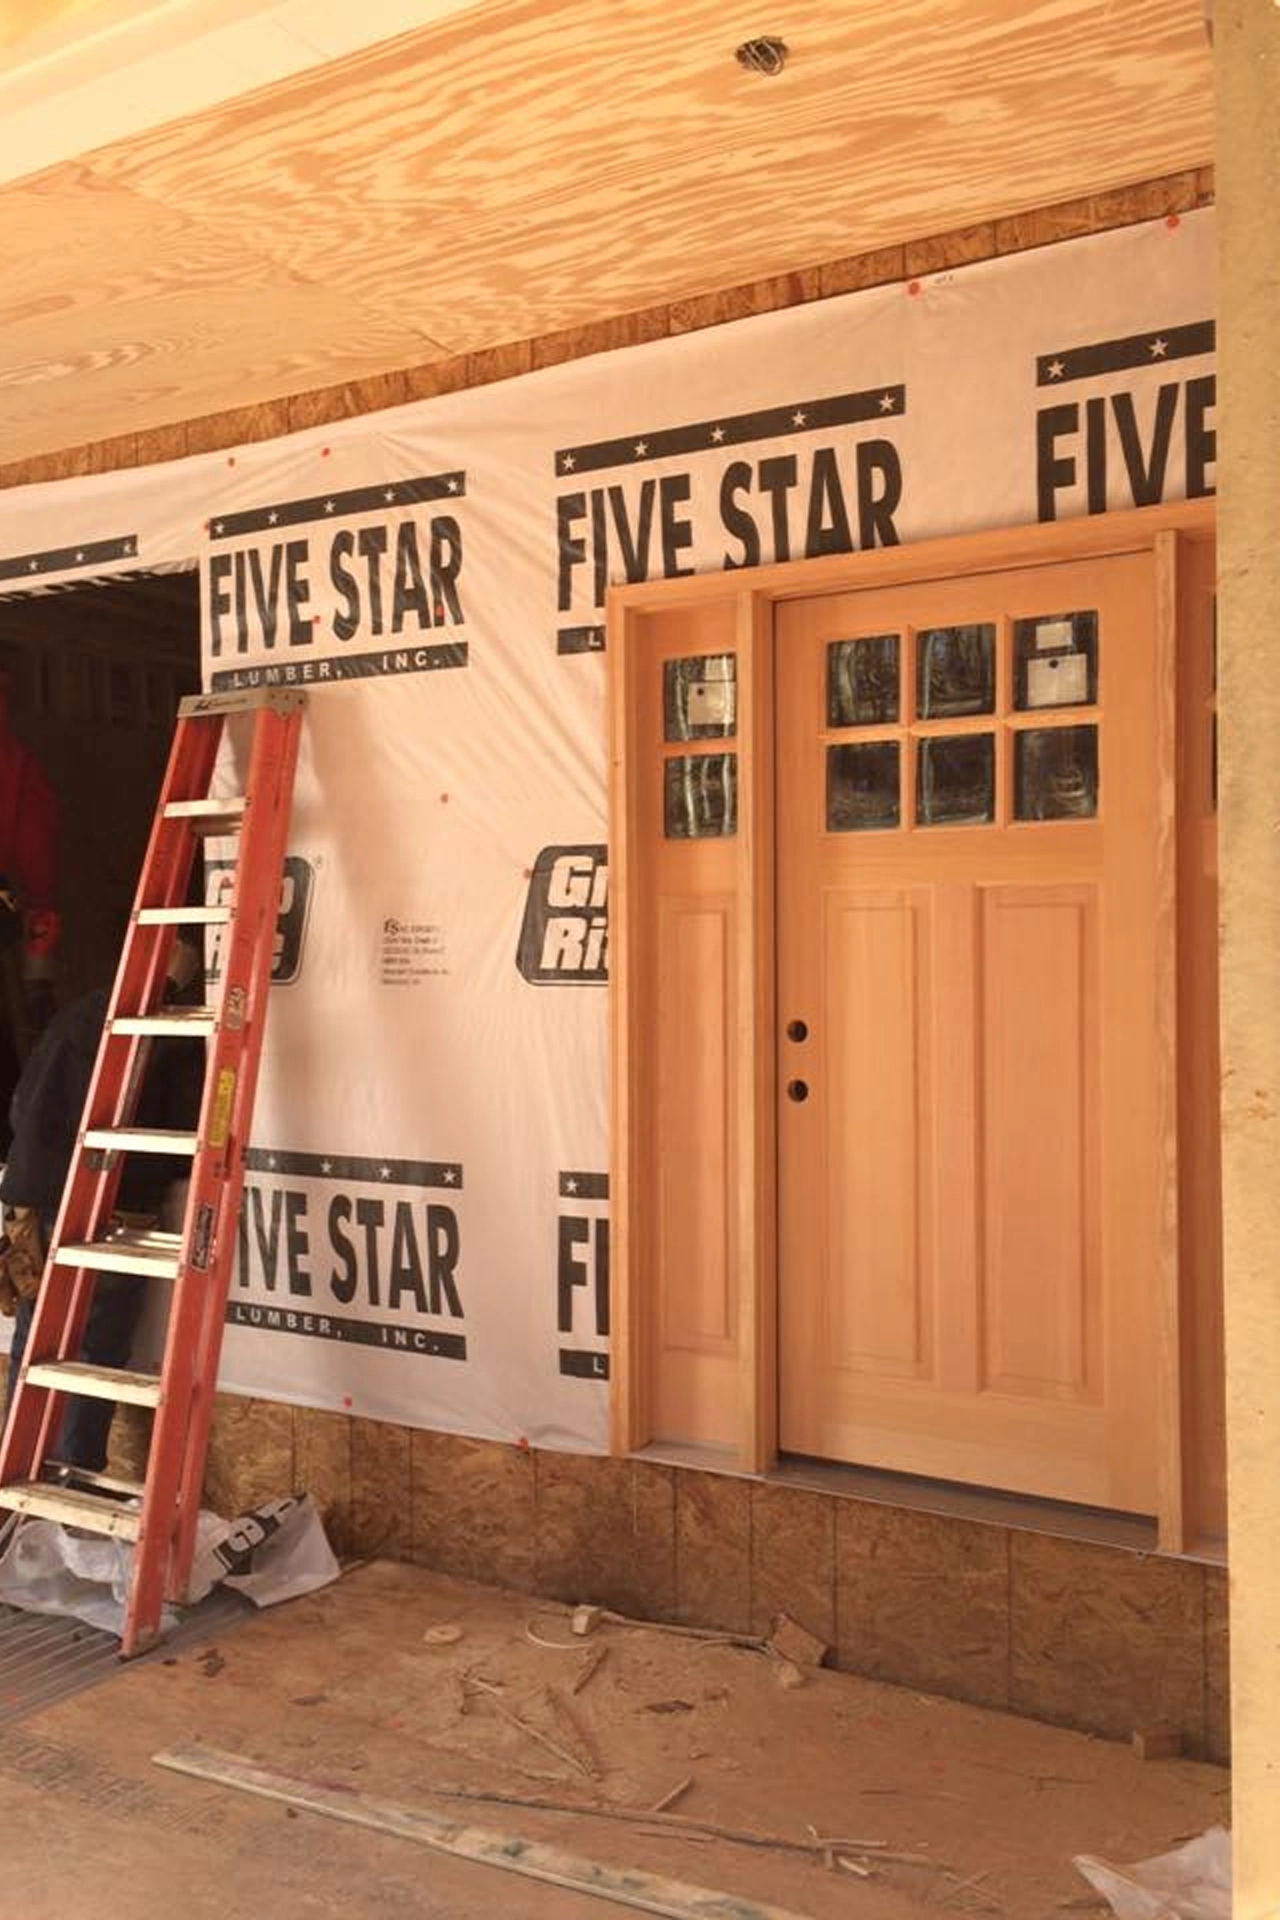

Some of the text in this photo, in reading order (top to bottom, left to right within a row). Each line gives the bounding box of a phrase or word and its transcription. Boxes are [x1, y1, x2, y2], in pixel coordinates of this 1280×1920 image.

[1037, 374, 1216, 523] FIVE
[209, 515, 465, 657] FIVE STAR
[556, 438, 903, 612] FIVE STAR
[232, 650, 441, 688] LUMBER, INC.
[540, 916, 608, 970] Ri
[238, 1186, 313, 1297] IVE
[328, 1193, 465, 1319] STAR
[557, 1215, 610, 1337] FI
[235, 1307, 440, 1352] LUMBER, INC.
